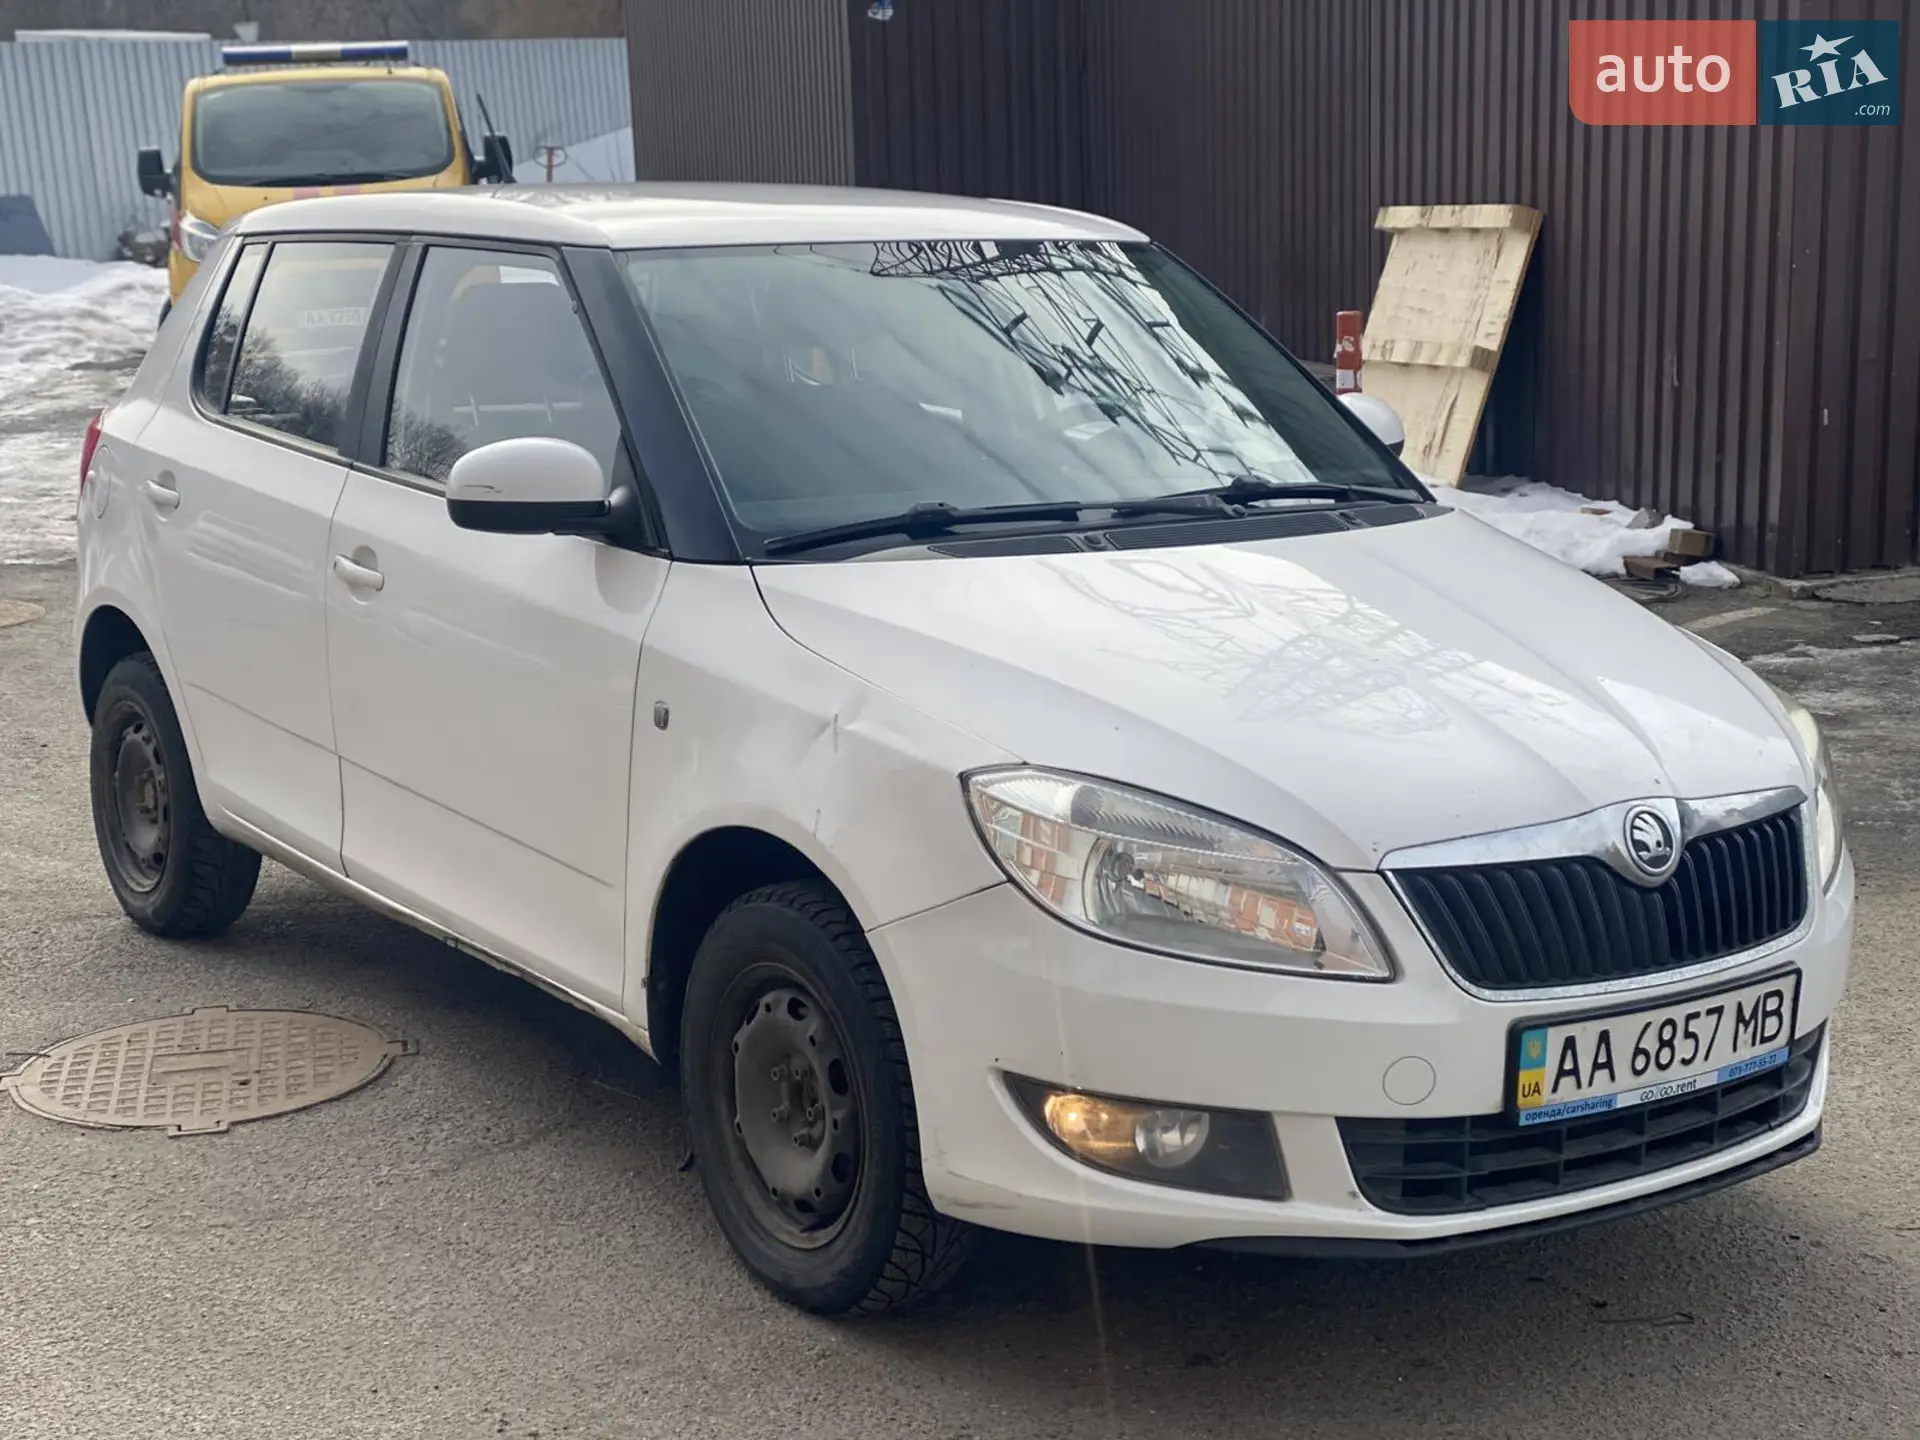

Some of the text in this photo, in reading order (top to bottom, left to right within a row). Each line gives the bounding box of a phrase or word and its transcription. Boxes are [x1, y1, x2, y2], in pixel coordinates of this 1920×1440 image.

[1550, 988, 1784, 1094] AA 6857 MB
[1521, 1081, 1541, 1098] UA
